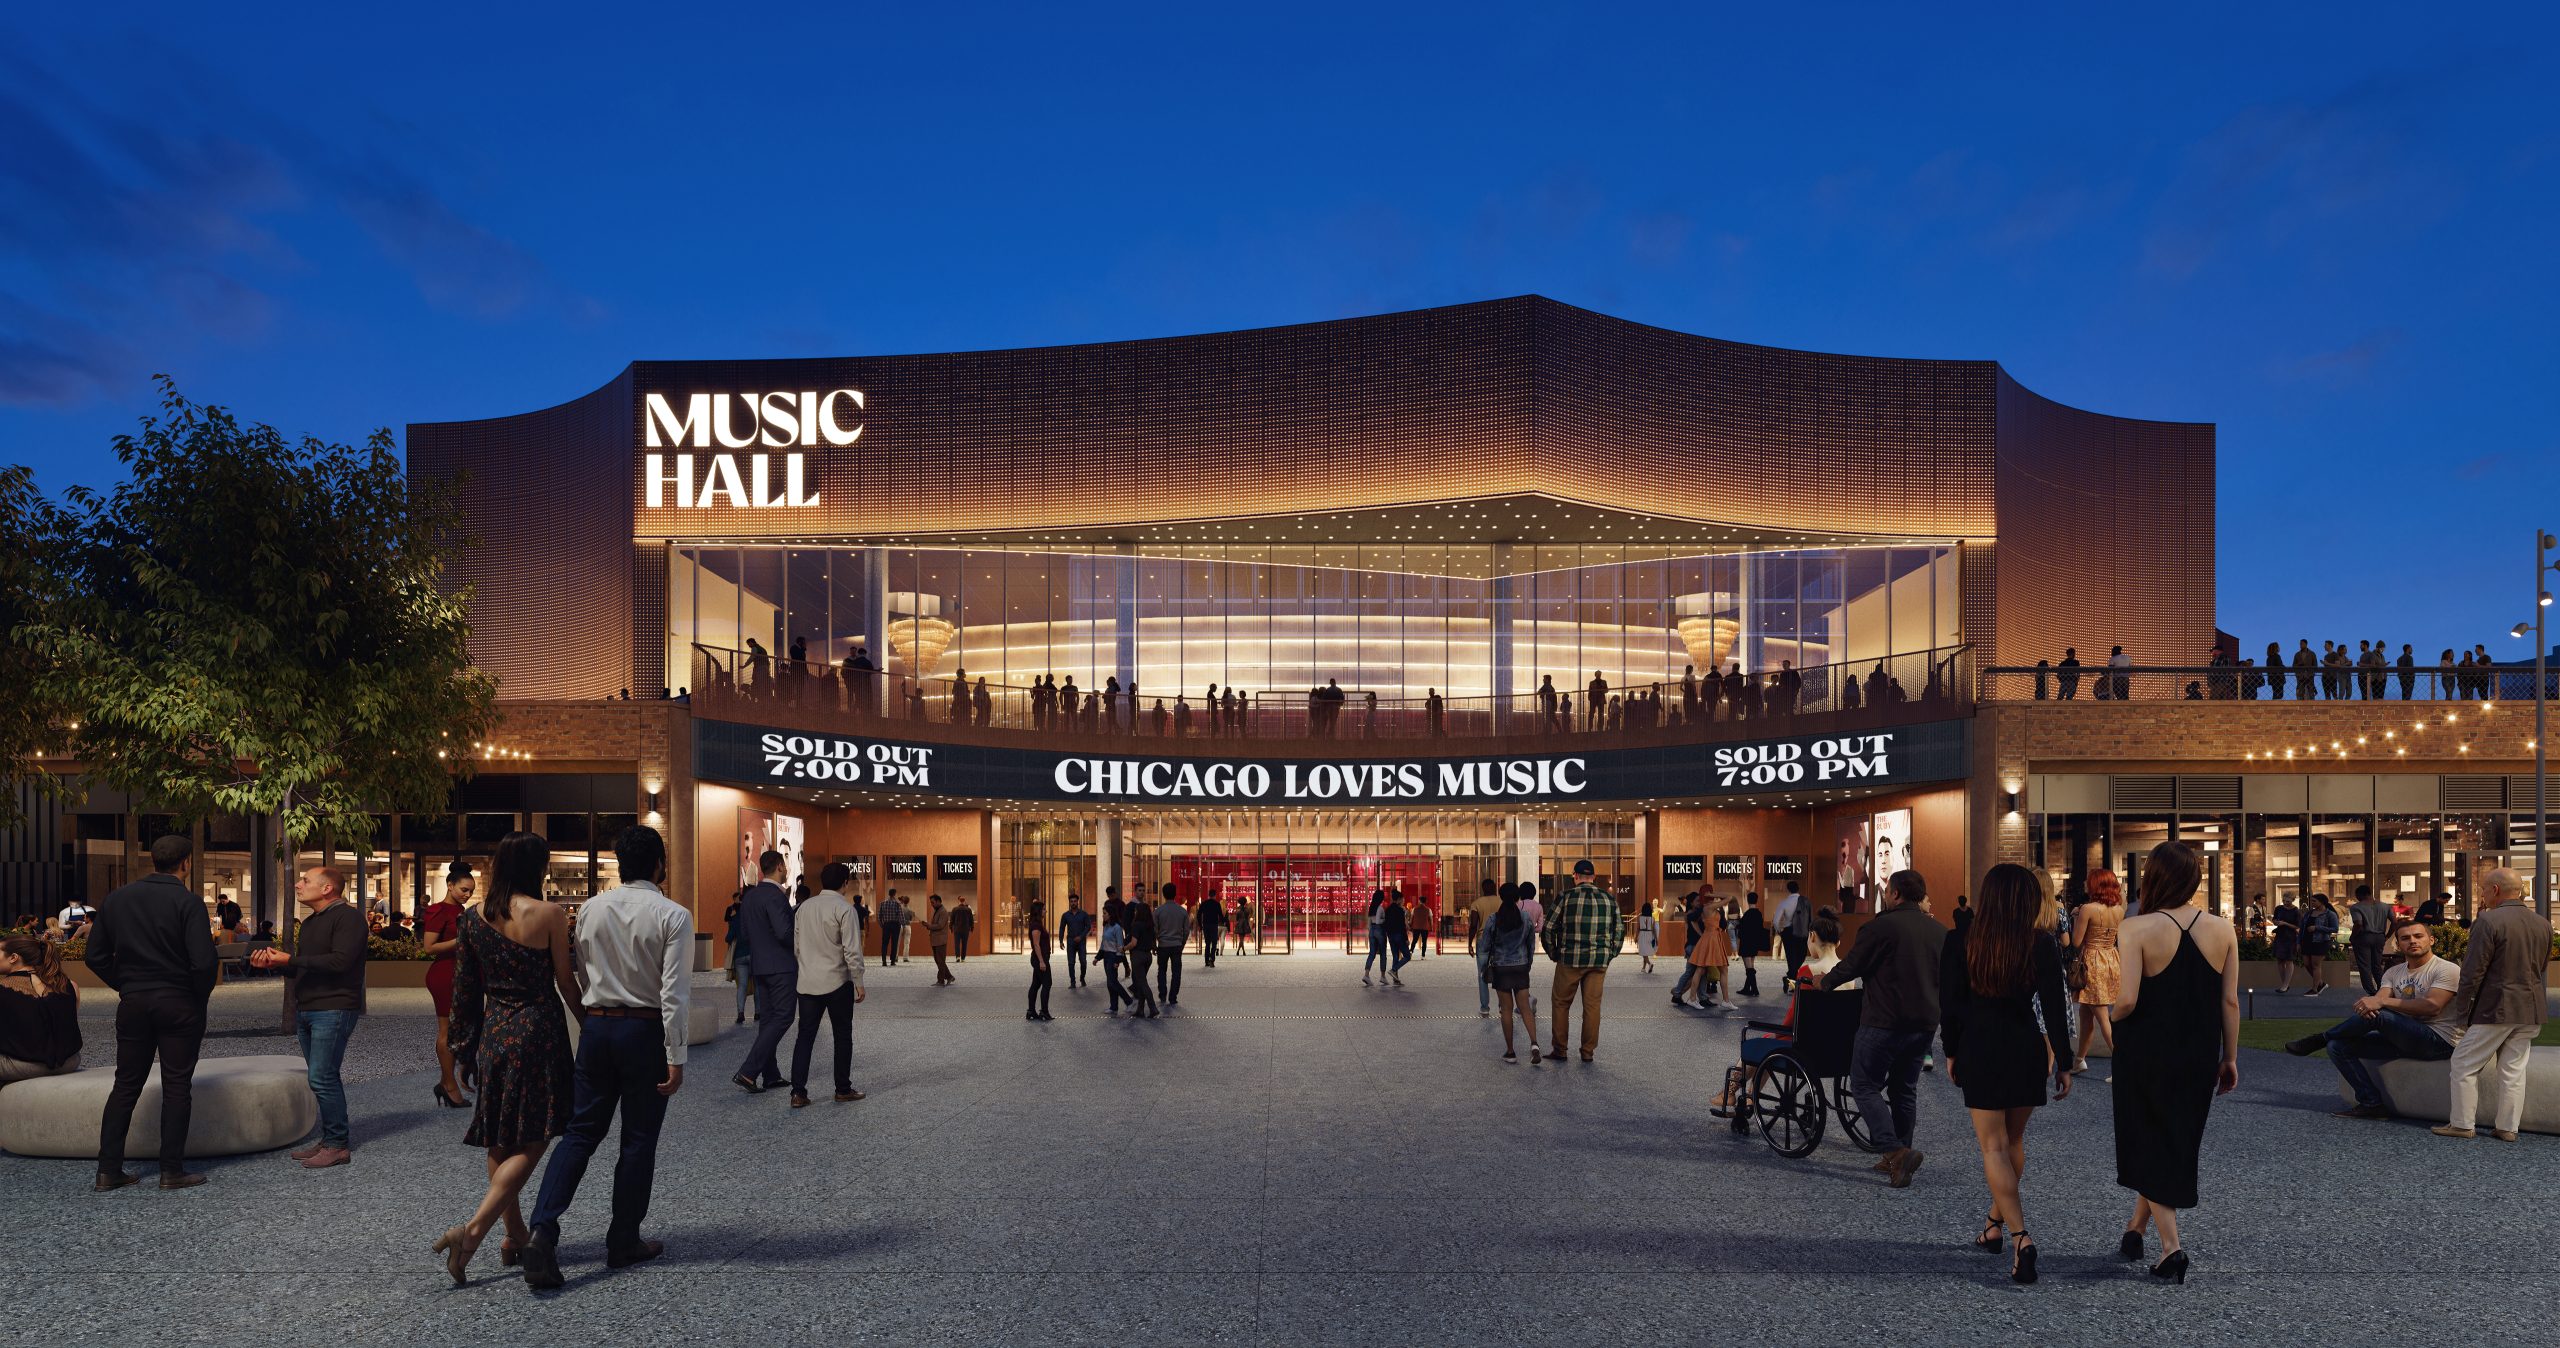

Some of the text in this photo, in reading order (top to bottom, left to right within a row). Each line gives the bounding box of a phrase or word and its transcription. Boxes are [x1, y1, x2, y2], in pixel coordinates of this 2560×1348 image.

[645, 389, 864, 448] MUSIC
[645, 453, 820, 508] HALL
[761, 733, 933, 766] SOLD OUT
[1714, 733, 1893, 767] SOLD OUT
[765, 754, 930, 787] 7:00 PM
[1054, 758, 1587, 798] CHICAGO LOVES MUSIC
[1717, 754, 1889, 787] 7:00 PM
[891, 862, 921, 874] TICKETS
[943, 862, 973, 874] TICKETS
[1666, 862, 1702, 874] TICKETS
[1717, 862, 1753, 874] TICKETS
[1766, 862, 1802, 874] TICKETS
